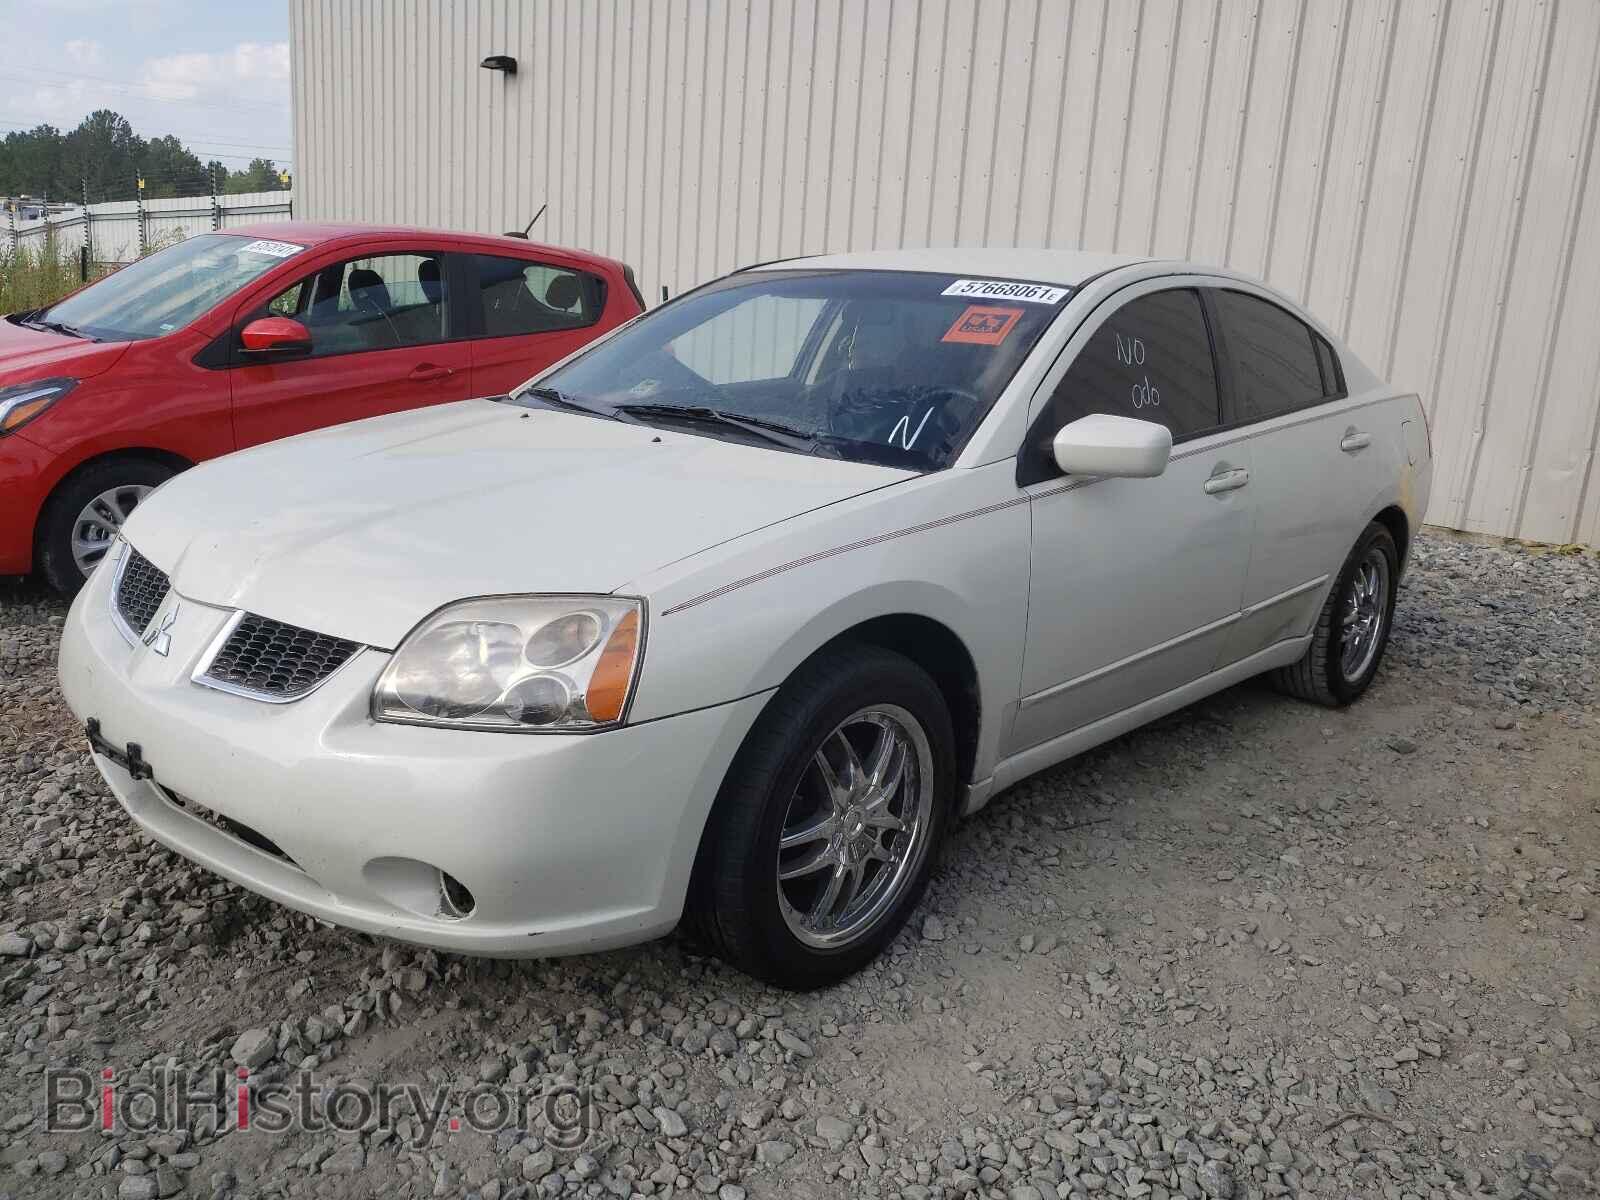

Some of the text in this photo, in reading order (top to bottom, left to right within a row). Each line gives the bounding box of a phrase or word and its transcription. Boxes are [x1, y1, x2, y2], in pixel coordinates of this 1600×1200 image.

[961, 281, 1049, 299] 57668061
[1116, 332, 1145, 365] NO
[887, 406, 935, 451] N
